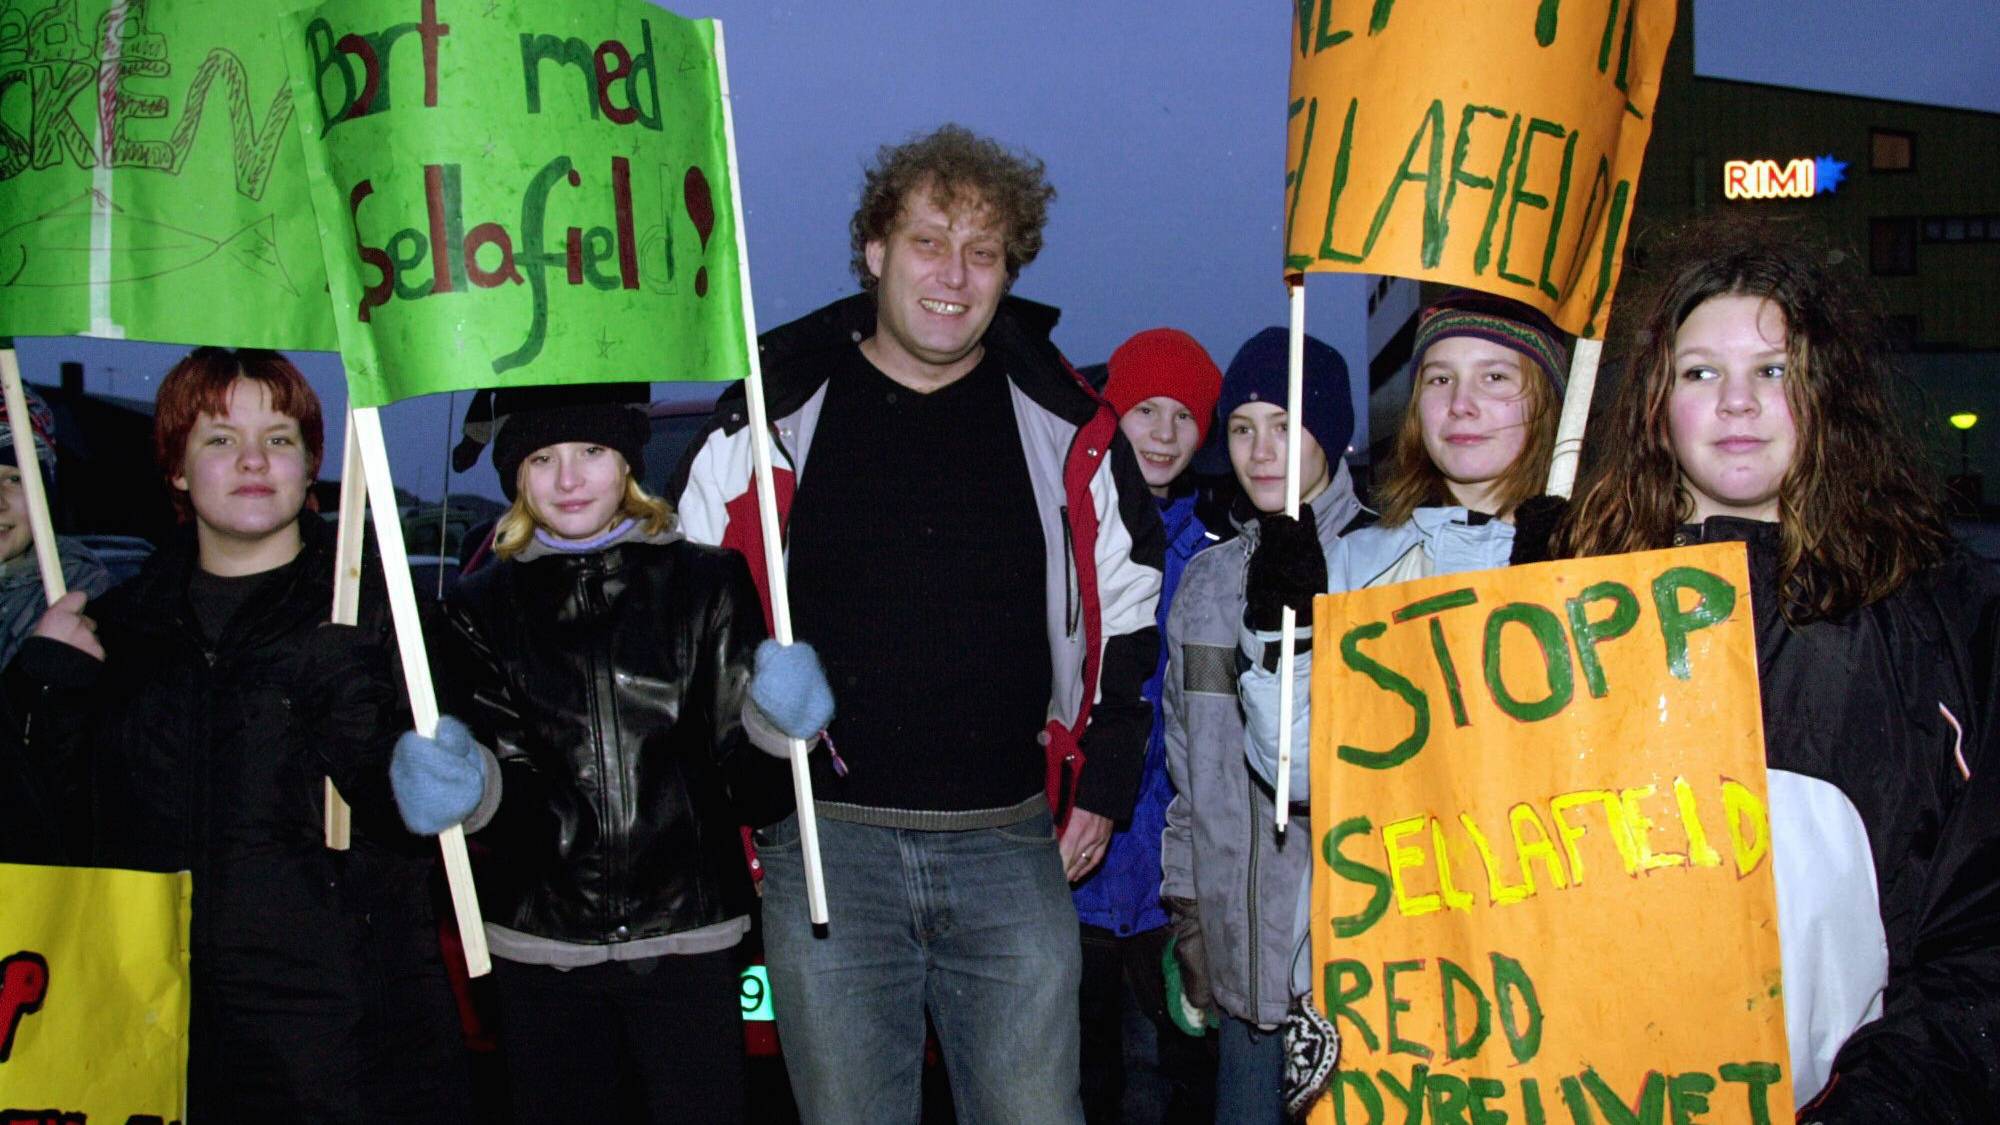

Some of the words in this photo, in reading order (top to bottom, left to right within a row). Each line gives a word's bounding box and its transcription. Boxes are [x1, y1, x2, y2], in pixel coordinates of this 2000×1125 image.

[306, 0, 450, 140] Bort
[519, 19, 664, 131] med
[1724, 159, 1815, 199] RIMI
[1337, 567, 1736, 769] STOPP
[1323, 952, 1544, 1066] REDD
